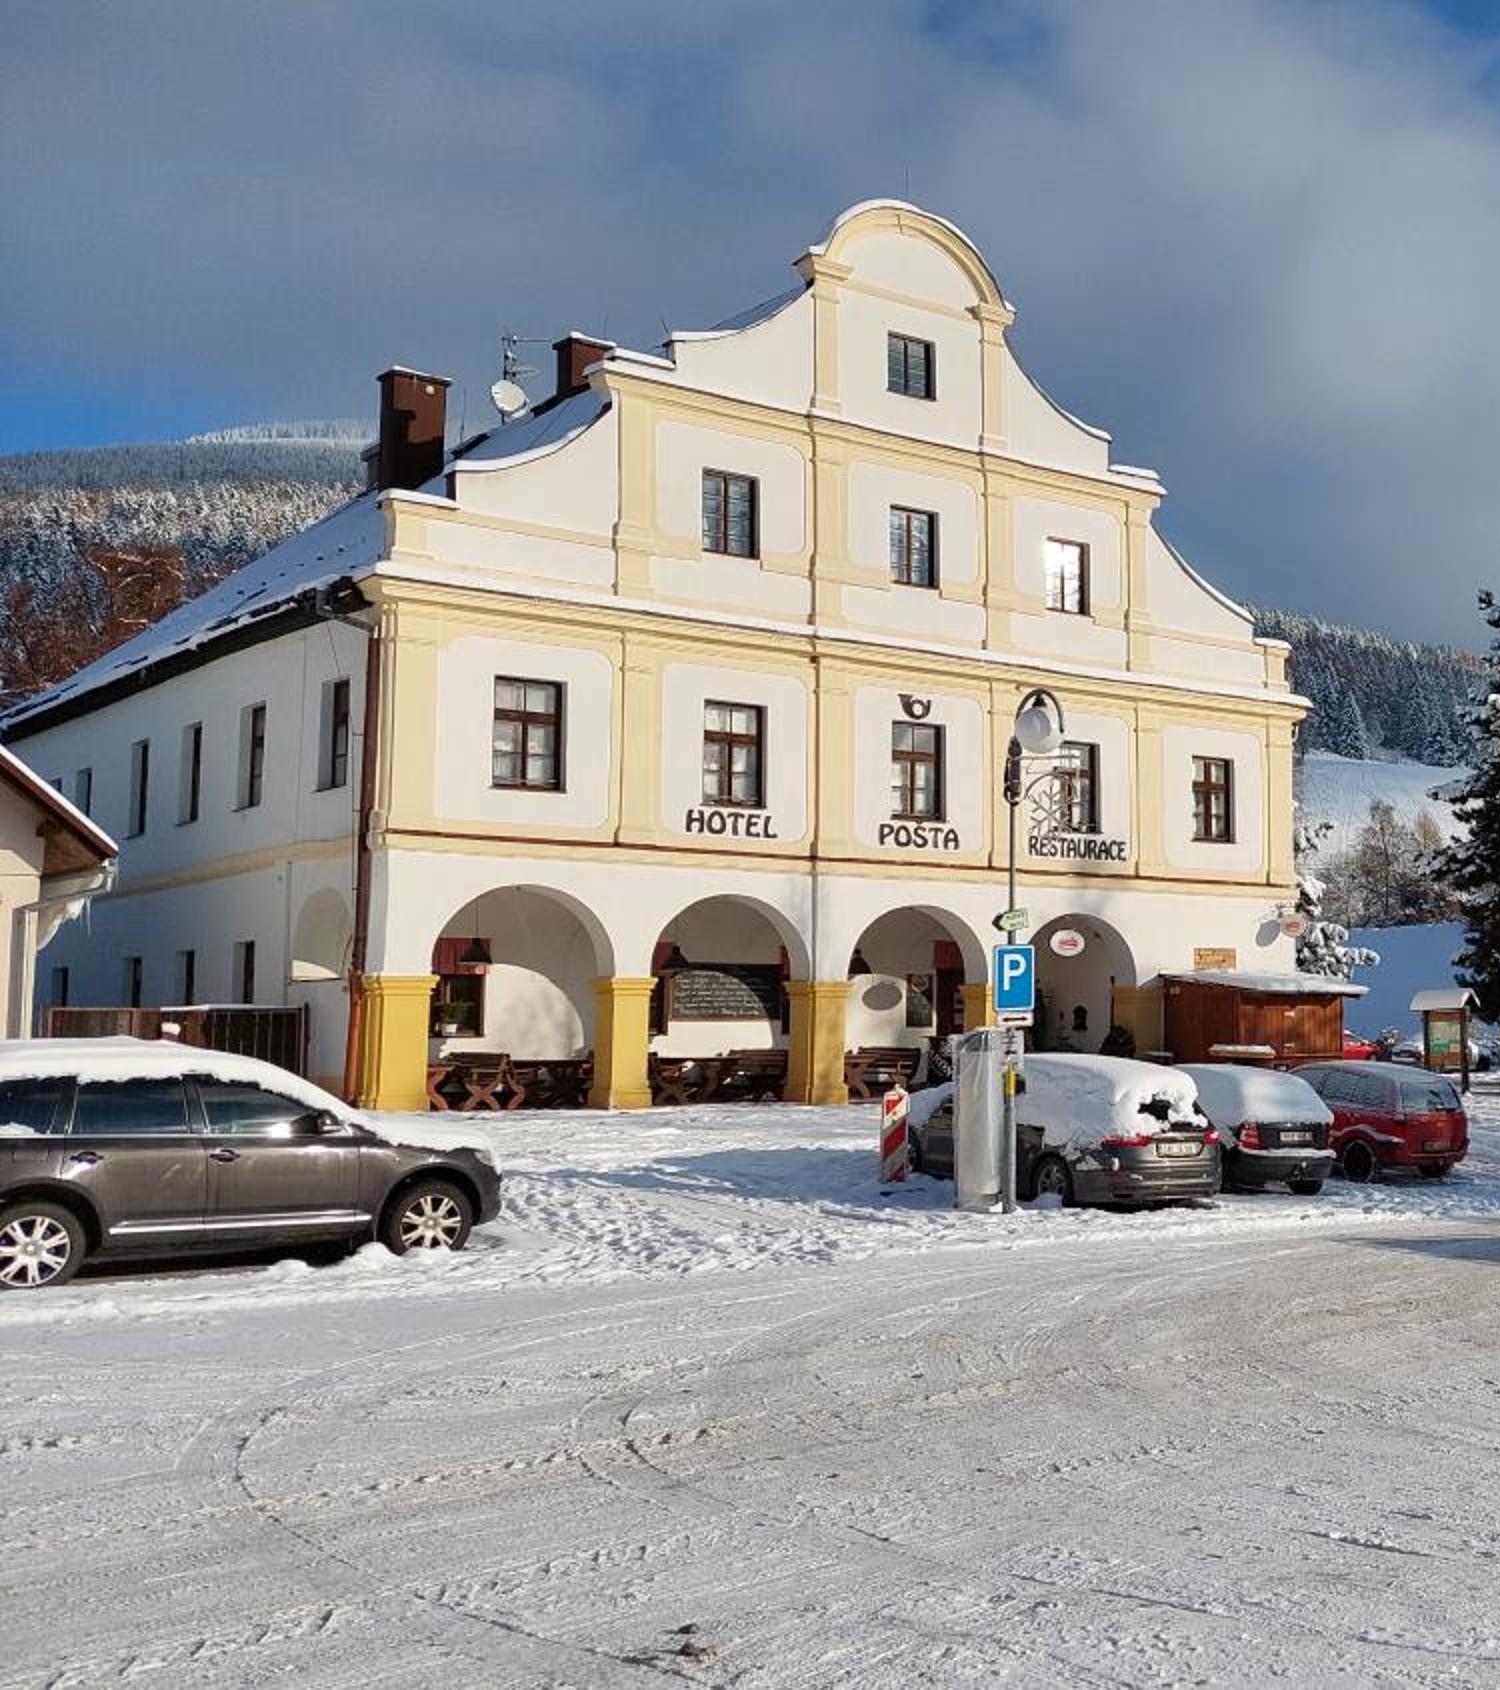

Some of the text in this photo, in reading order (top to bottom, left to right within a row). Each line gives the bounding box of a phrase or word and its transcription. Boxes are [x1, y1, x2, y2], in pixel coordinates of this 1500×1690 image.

[685, 809, 778, 838] HOTEL
[878, 818, 960, 850] POŠTA
[1028, 835, 1127, 861] RESTAURACE
[1003, 953, 1027, 991] P
